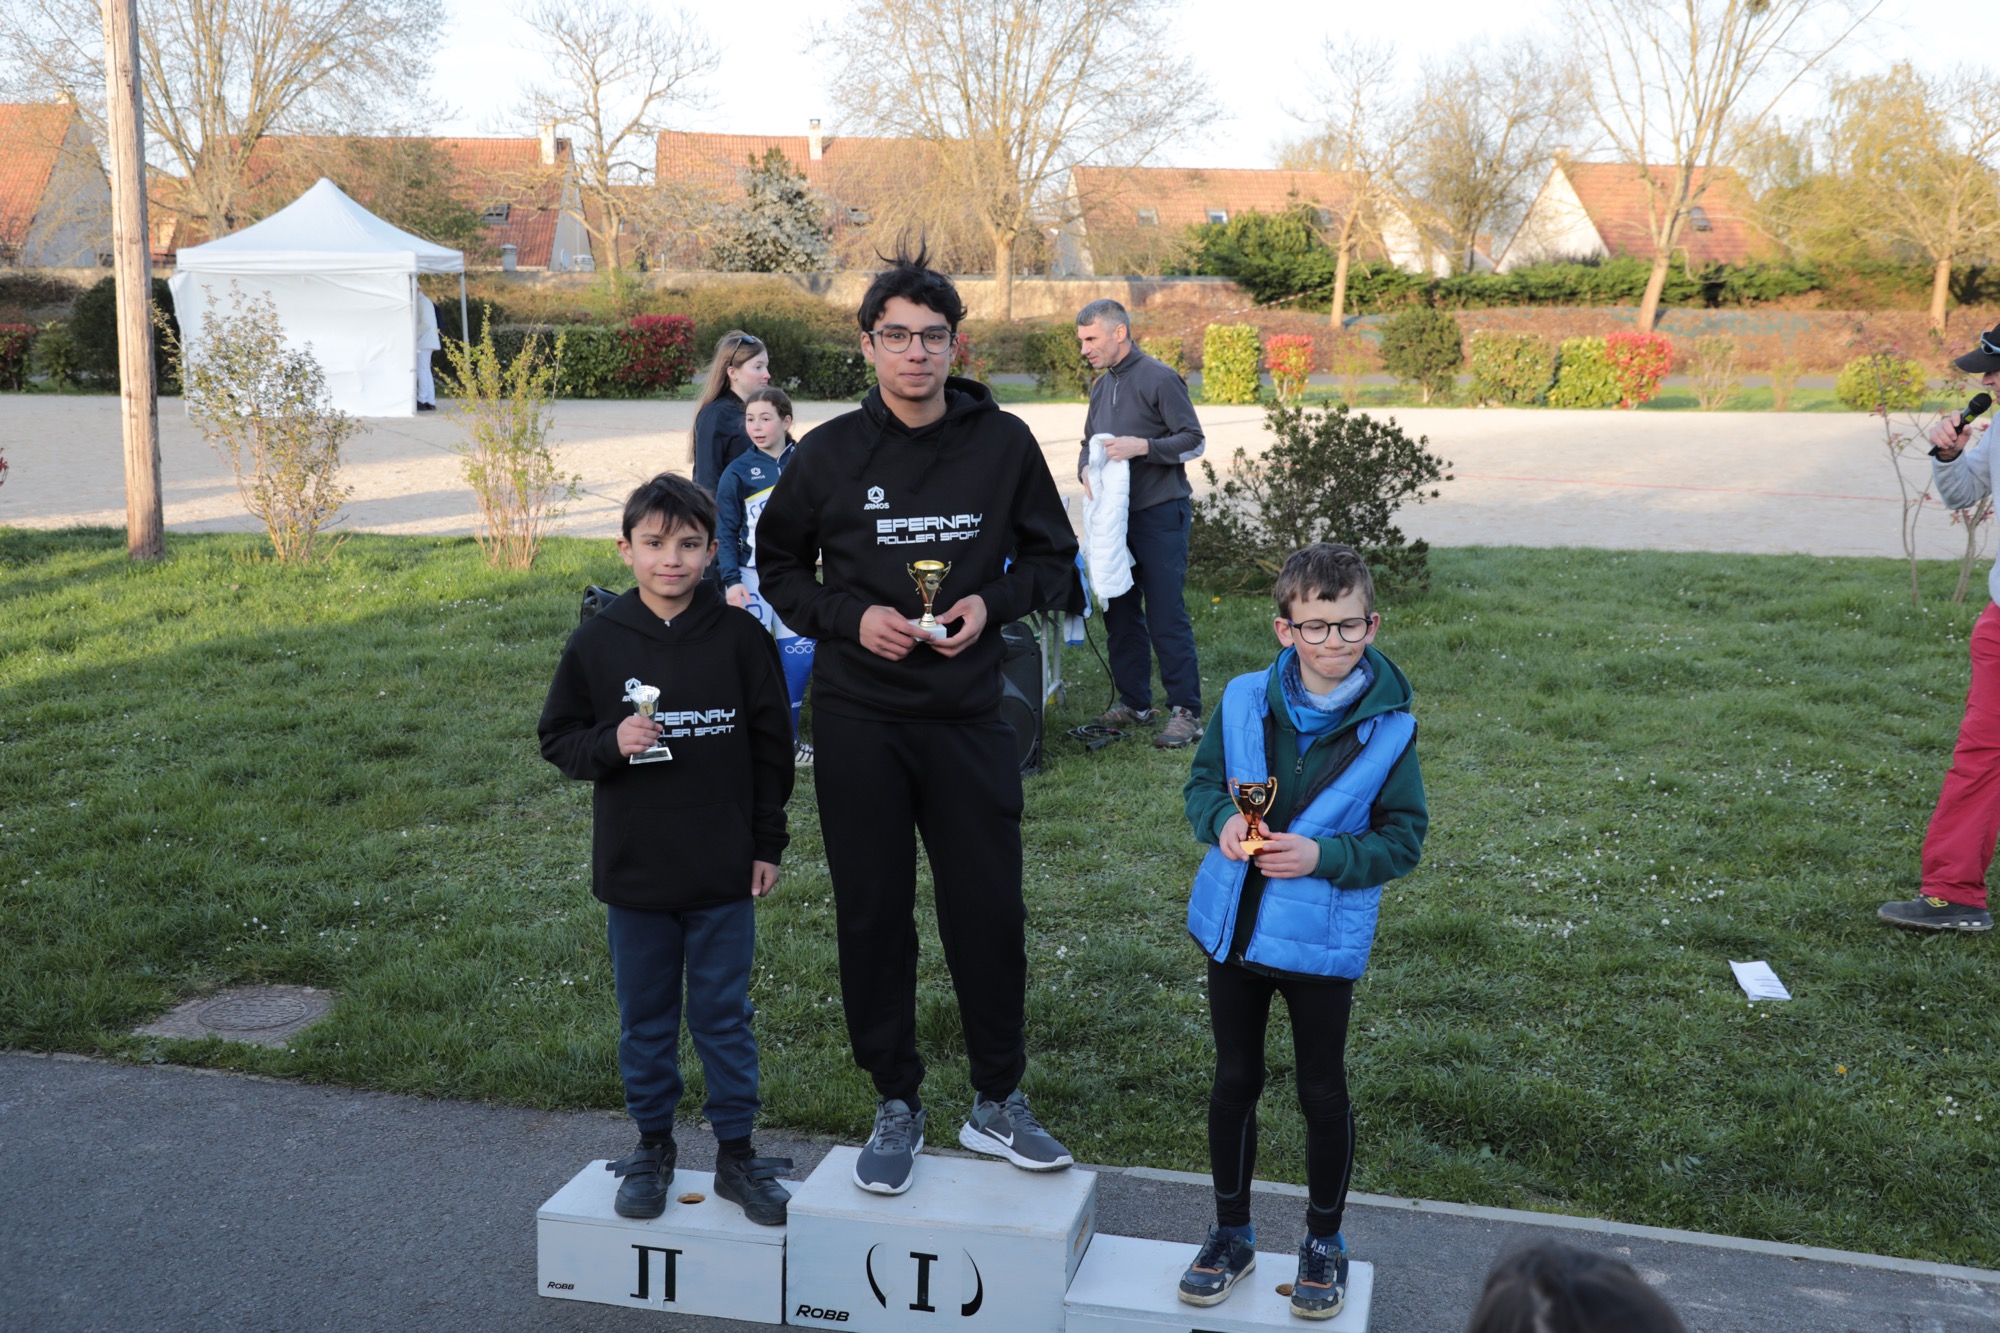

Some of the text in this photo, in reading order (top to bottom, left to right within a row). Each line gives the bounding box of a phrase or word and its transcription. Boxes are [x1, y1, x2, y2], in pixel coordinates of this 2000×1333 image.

[863, 502, 890, 511] ARMOS
[876, 513, 983, 534] EPERNAY
[877, 529, 980, 545] ROLLER SPORT
[634, 708, 736, 726] PERNAY
[694, 725, 735, 737] SPORT
[547, 1281, 575, 1290] ROBB
[796, 1304, 850, 1321] ROBB
